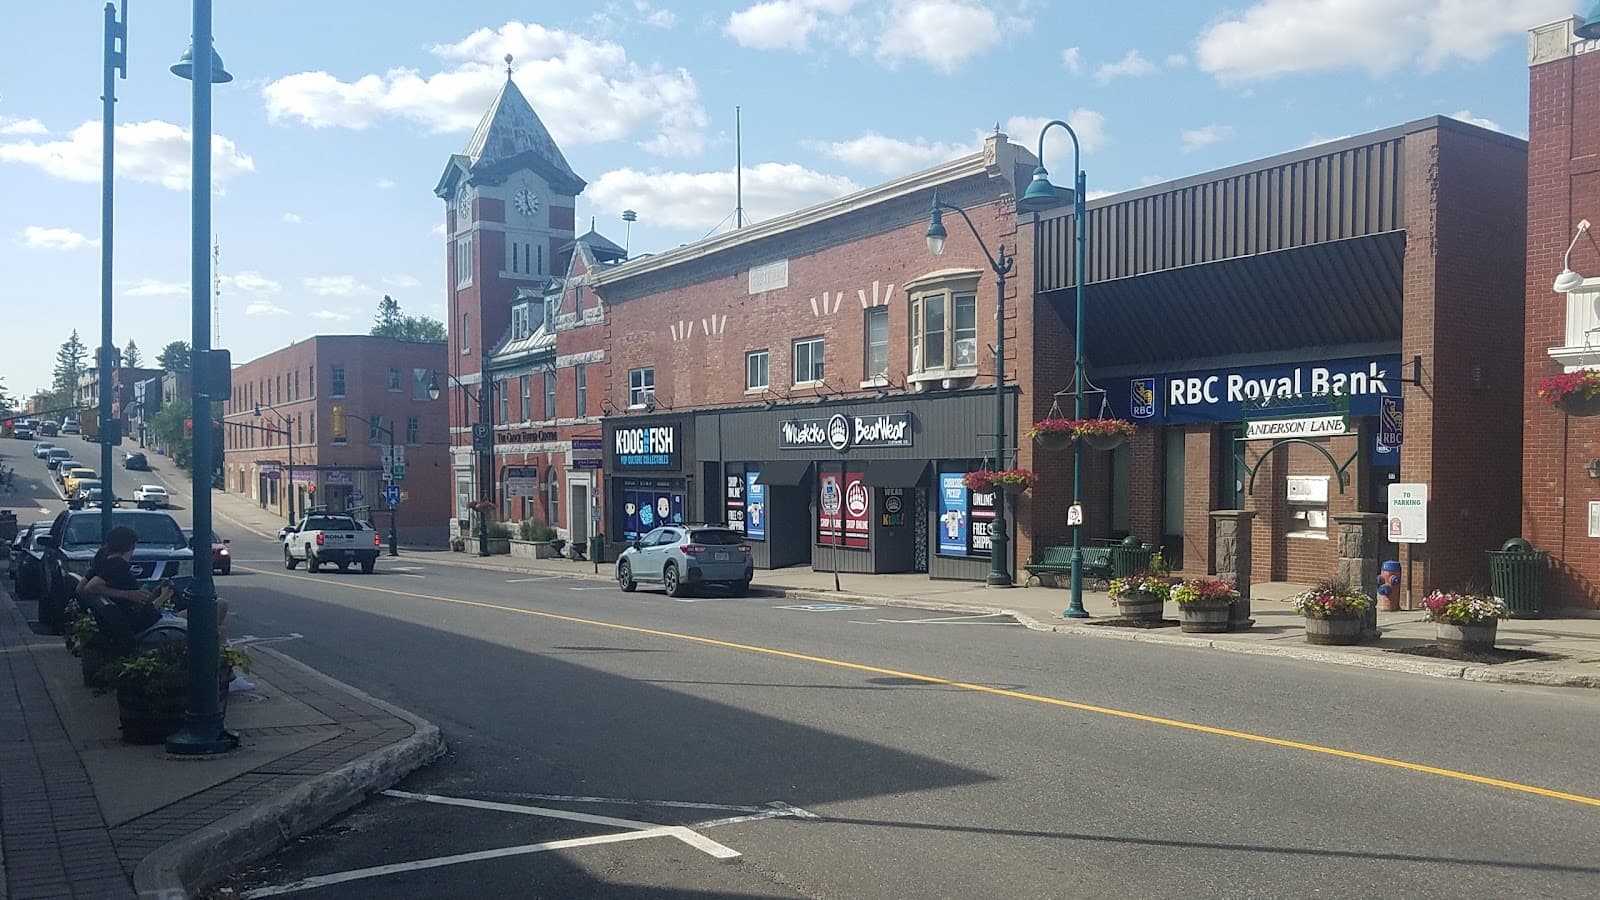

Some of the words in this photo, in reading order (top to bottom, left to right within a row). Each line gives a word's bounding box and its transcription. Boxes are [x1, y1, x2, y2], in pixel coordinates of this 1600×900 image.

[1170, 375, 1219, 406] RBC
[1228, 368, 1303, 407] Royal
[1312, 361, 1389, 398] Bank
[1133, 406, 1153, 415] RBC
[782, 421, 826, 444] Muskoka
[854, 415, 907, 445] BearWear
[1247, 420, 1306, 436] ANDERSON
[1310, 418, 1344, 432] LANE
[649, 426, 674, 454] FISH
[1383, 432, 1402, 444] RBC
[972, 492, 994, 506] ONLINE
[972, 522, 987, 536] FREE
